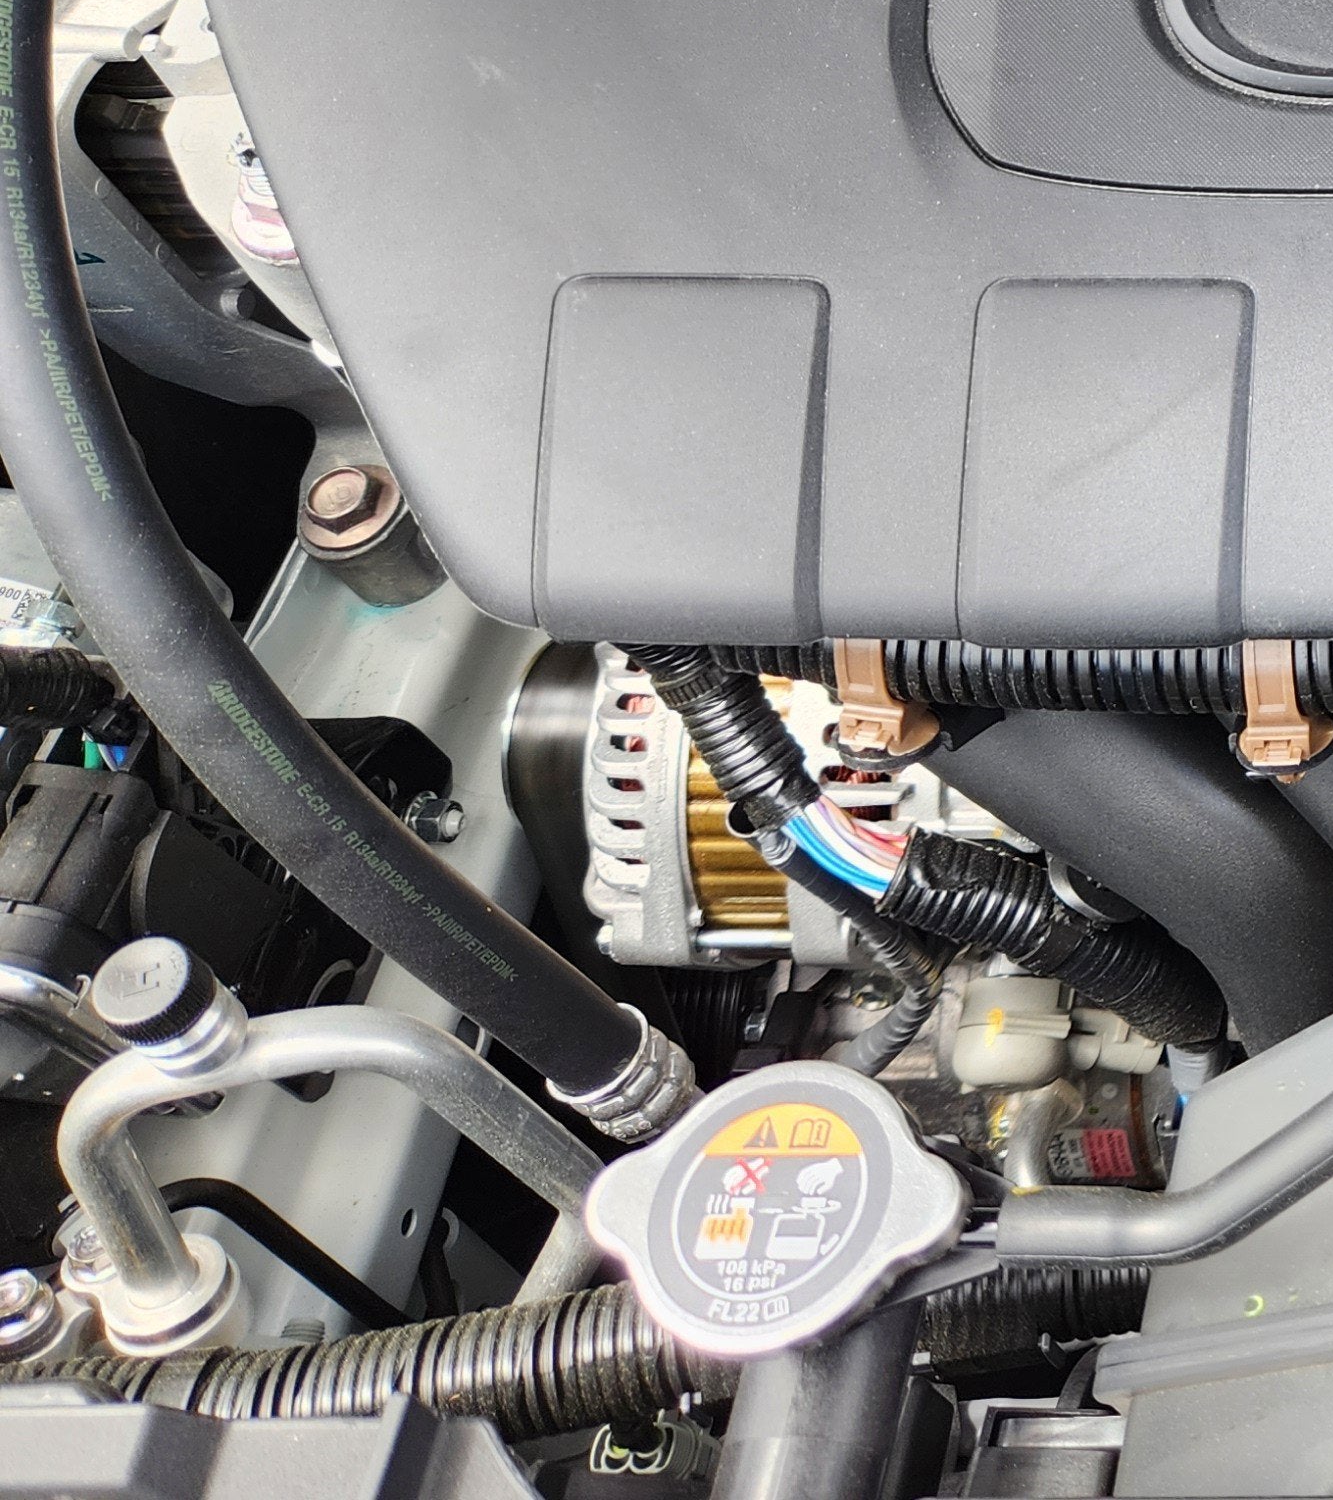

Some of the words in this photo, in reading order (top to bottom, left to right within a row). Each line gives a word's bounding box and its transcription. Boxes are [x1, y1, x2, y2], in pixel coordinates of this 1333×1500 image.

[6, 186, 49, 319] R134a/R1234yf
[207, 679, 301, 784] BRIDGESTONE
[343, 831, 424, 904] R134a/R1234yf
[717, 1259, 747, 1277] 108
[752, 1258, 786, 1276] kPa
[723, 1276, 745, 1292] 16
[748, 1274, 776, 1292] psi
[708, 1298, 760, 1323] FL22
